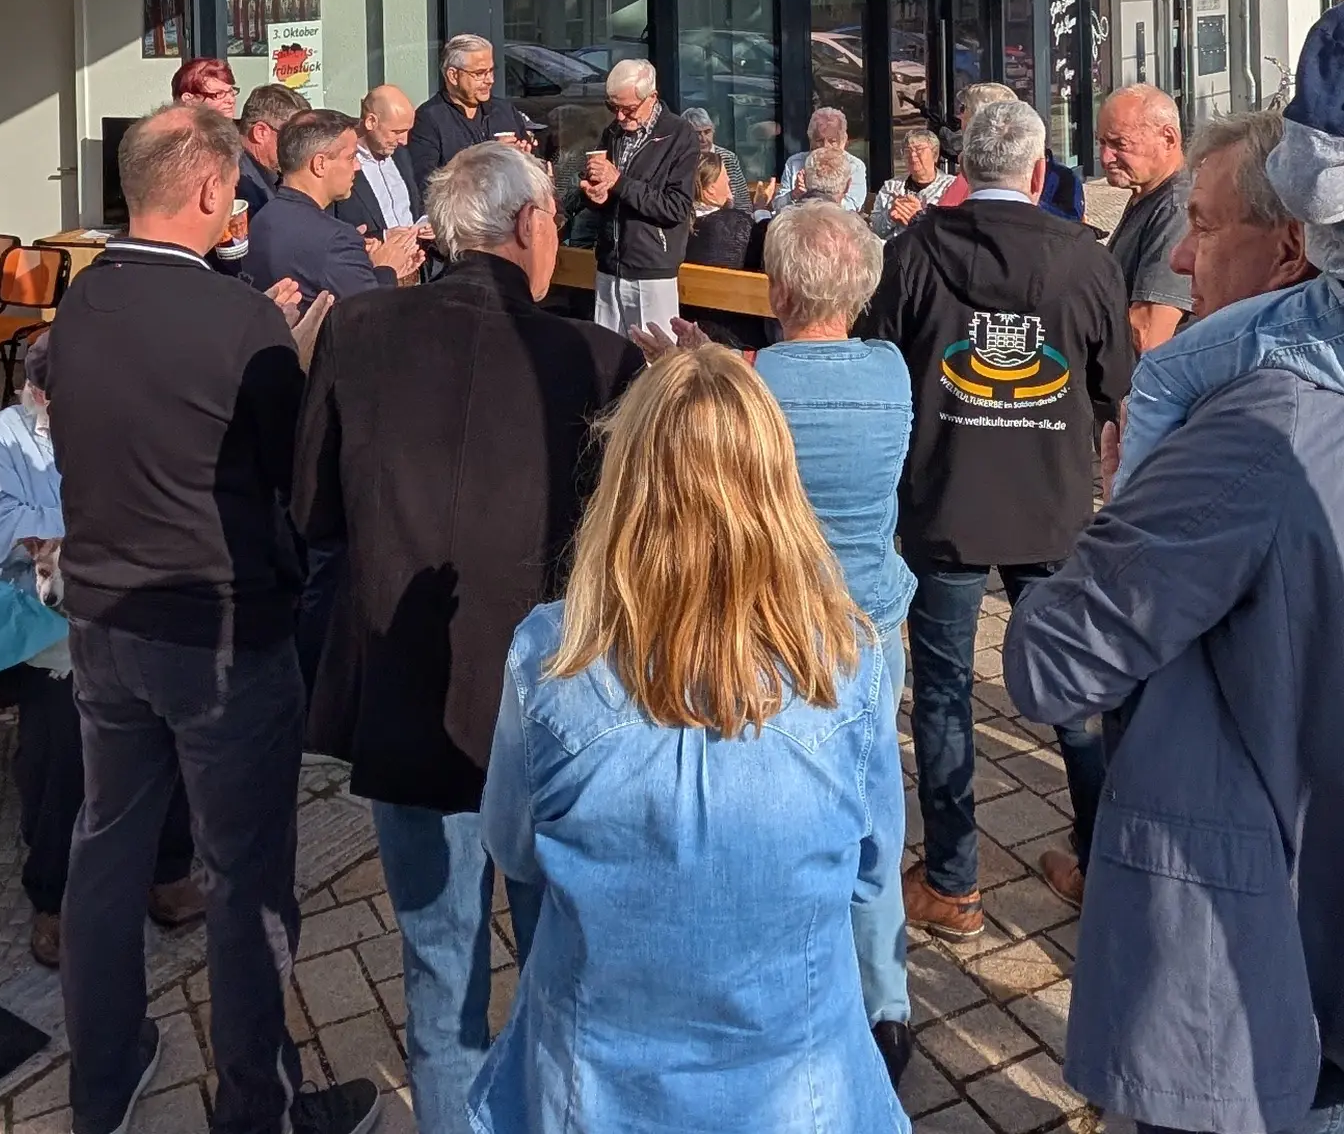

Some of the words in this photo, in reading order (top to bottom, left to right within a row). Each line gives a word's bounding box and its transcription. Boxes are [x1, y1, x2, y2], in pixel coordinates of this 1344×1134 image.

[273, 29, 281, 39] 3.
[283, 26, 319, 38] Oktober
[940, 375, 1003, 409] WELTKULTURERBE
[939, 411, 1067, 431] www.weltkulturerbe-slk.de
